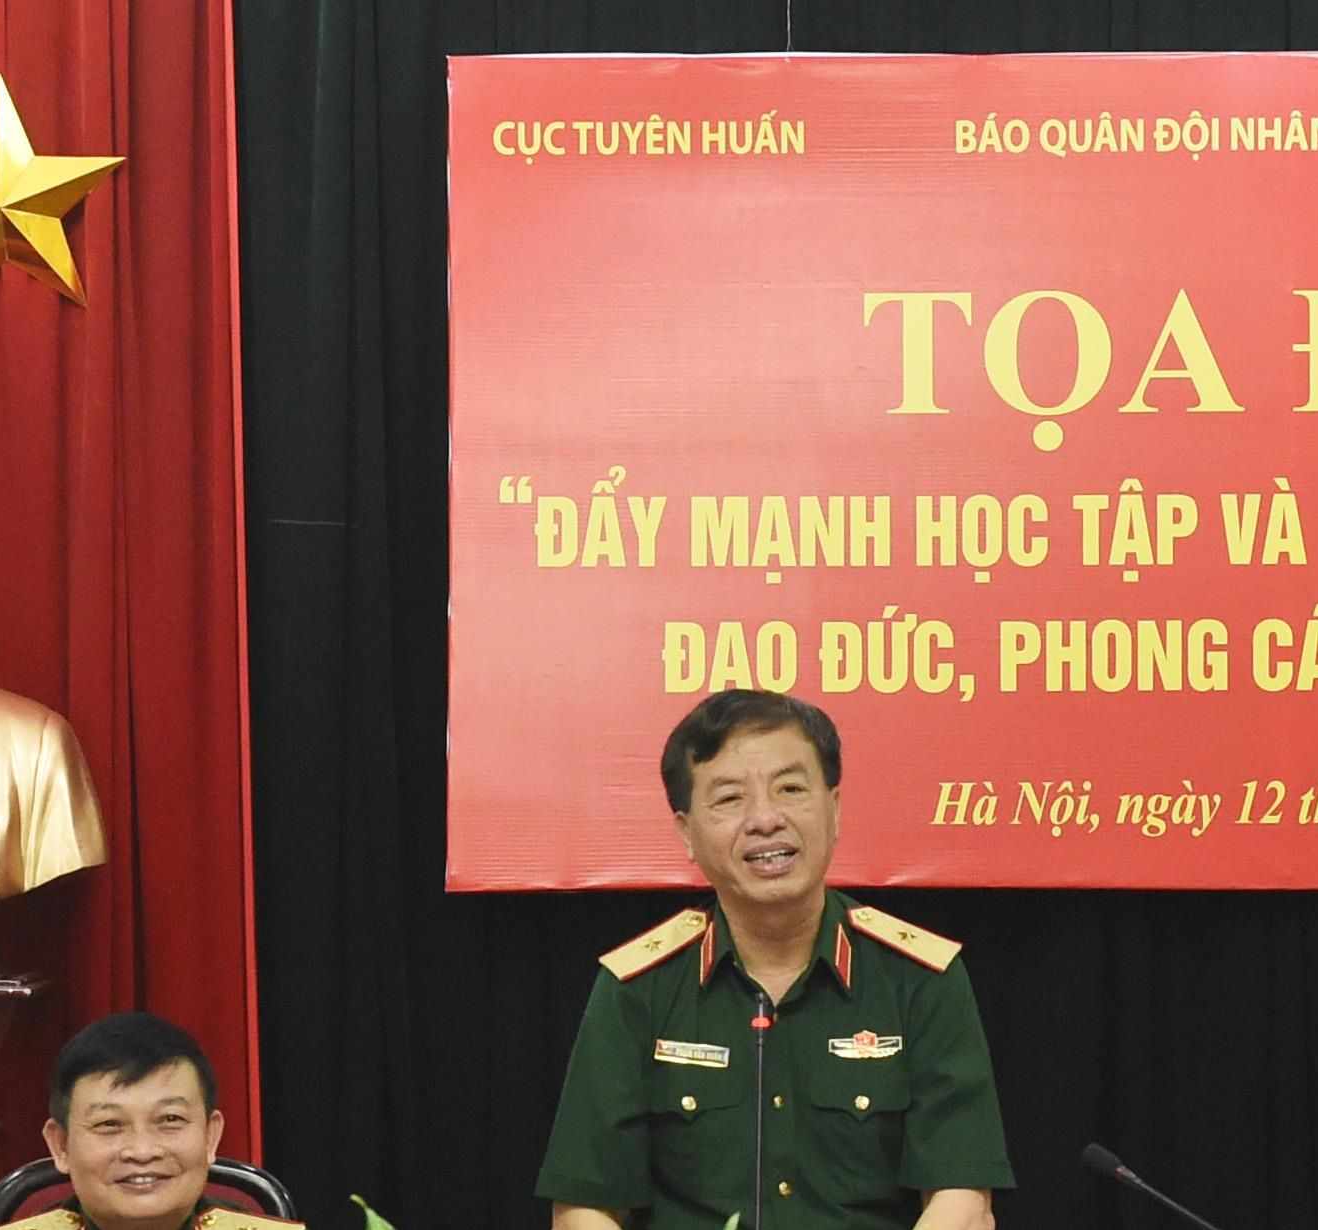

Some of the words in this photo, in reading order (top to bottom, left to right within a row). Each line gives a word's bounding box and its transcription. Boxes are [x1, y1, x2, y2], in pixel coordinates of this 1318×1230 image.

[494, 120, 565, 166] CỤC
[573, 112, 691, 156] TUYÊN
[702, 107, 805, 156] HUẤN
[956, 111, 1030, 155] BÁO
[1040, 112, 1146, 157] QUÂN
[1154, 111, 1220, 163] ĐỘI
[864, 289, 1244, 451] TỌA
[690, 495, 891, 584] MẠNH
[916, 494, 1048, 584] HỌC
[1073, 477, 1198, 583] TẬP
[1221, 477, 1307, 566] VÀ
[819, 605, 974, 702] ĐỨC,
[1000, 619, 1228, 693] PHONG
[933, 780, 997, 826] Hà
[1011, 780, 1099, 838] Nội,
[1116, 780, 1221, 837] ngày
[1238, 780, 1285, 824] 12
